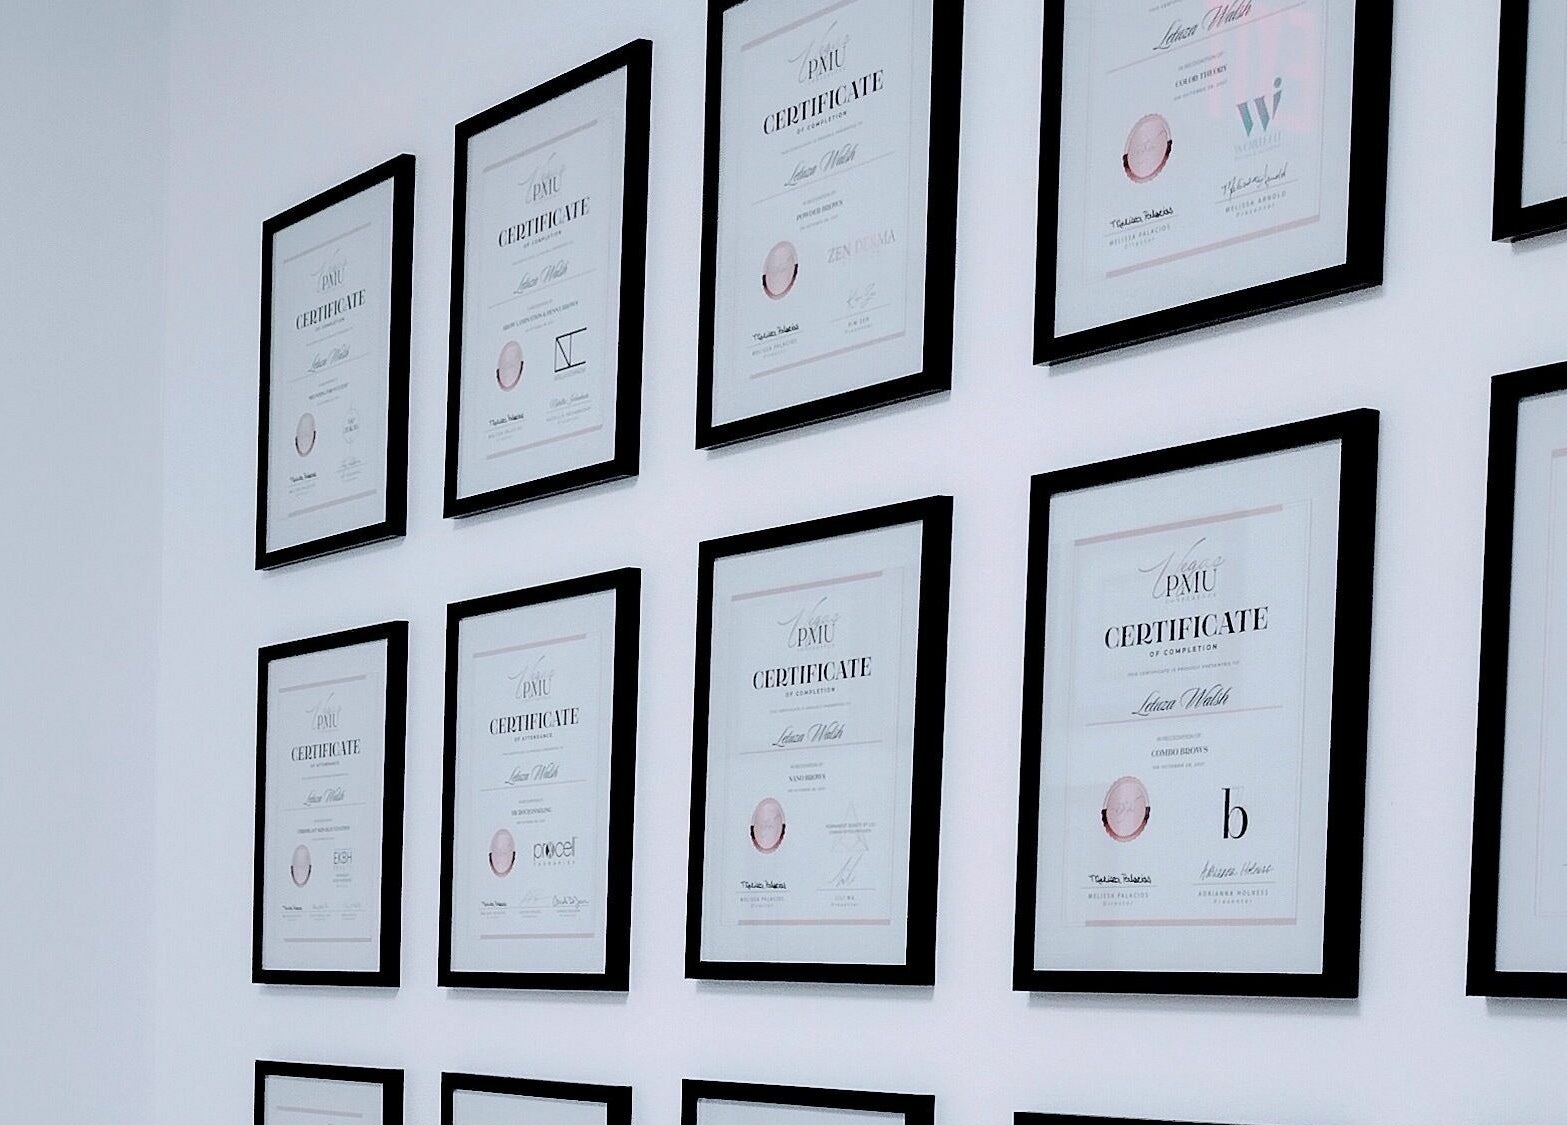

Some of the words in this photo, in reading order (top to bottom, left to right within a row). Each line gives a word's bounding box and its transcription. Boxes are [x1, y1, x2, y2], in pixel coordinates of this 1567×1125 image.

[808, 49, 843, 80] PMU
[763, 69, 884, 135] CERTIFICATE
[807, 111, 847, 131] COMPLETION
[498, 196, 591, 248] CERTIFICATE
[295, 289, 367, 331] CERTIFICATE
[1166, 568, 1218, 598] PMU
[797, 623, 836, 648] PMU
[1104, 605, 1270, 650] CERTIFICATE
[1163, 644, 1218, 657] COMPLETION
[753, 656, 872, 691] CERTIFICATE
[522, 677, 551, 699] PMU
[795, 687, 836, 698] COMPLETION
[1180, 683, 1233, 710] Walsh
[489, 707, 580, 736] CERTIFICATE
[808, 721, 845, 744] Walsh
[291, 738, 361, 762] CERTIFICATE
[1151, 748, 1179, 757] COMBO
